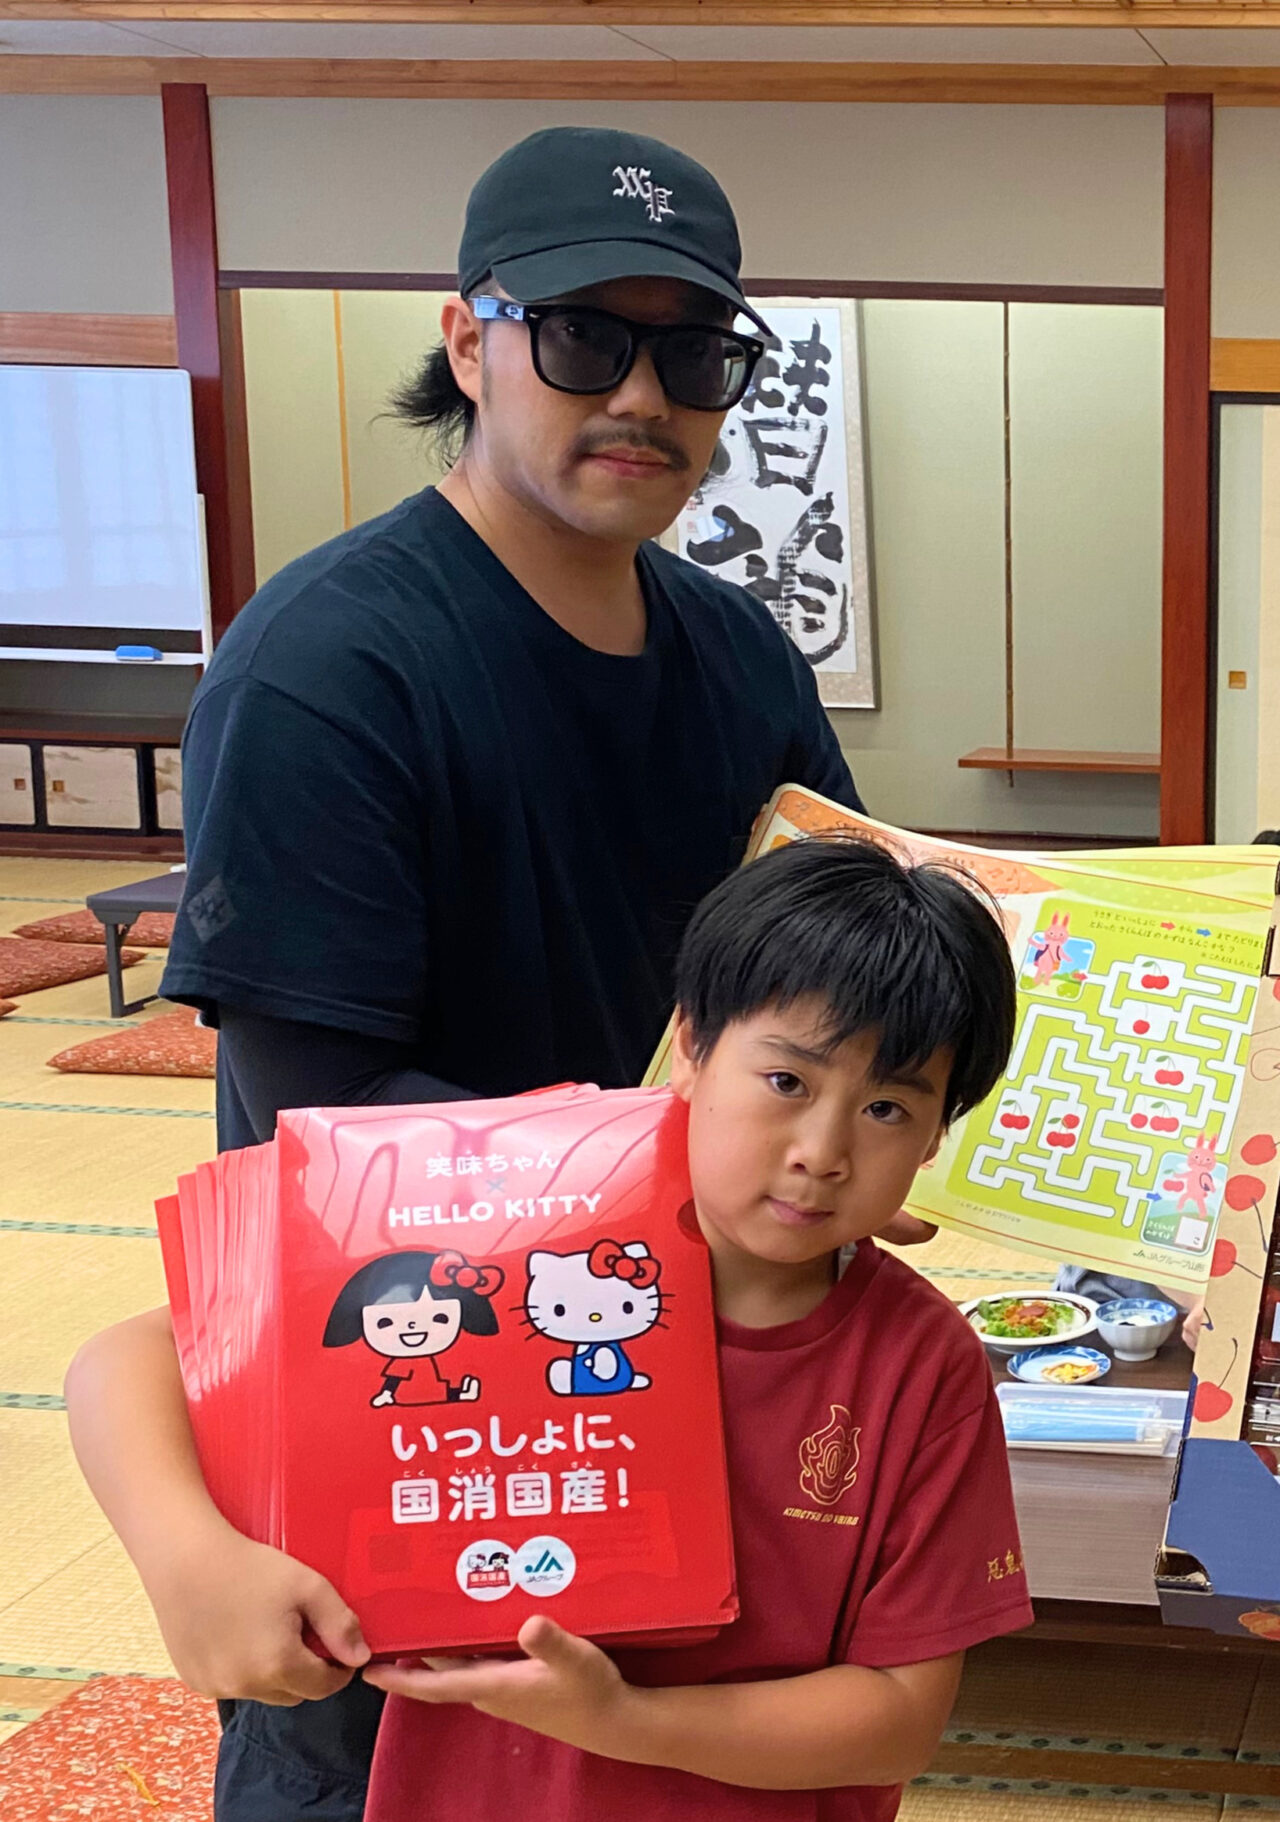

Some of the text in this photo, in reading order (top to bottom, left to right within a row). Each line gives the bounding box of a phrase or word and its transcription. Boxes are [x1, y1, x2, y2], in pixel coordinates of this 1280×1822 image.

[425, 1151, 561, 1178] 笑味ちゃん
[388, 1193, 602, 1228] HELLO KITTY
[391, 1412, 637, 1462] いっしょに、
